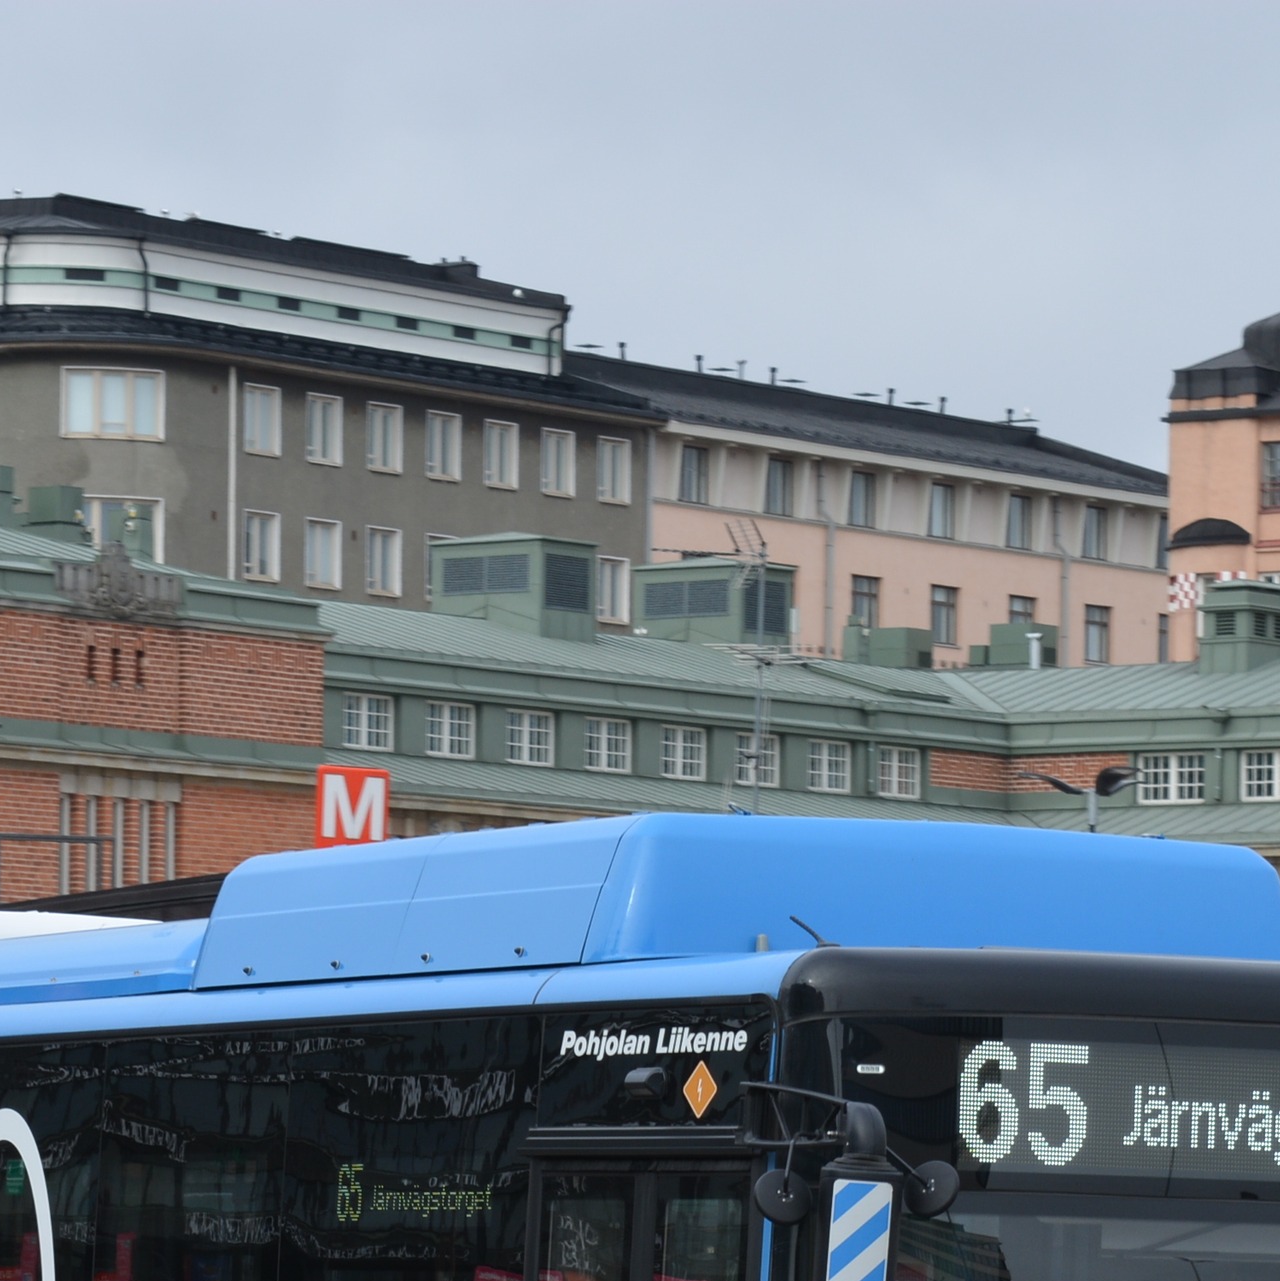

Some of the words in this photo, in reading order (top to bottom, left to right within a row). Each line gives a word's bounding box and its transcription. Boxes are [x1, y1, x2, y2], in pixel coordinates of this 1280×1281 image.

[320, 772, 387, 841] M
[561, 1029, 650, 1061] Pohjolan
[656, 1025, 748, 1055] Liikenne
[959, 1040, 1090, 1166] 65
[336, 1163, 364, 1222] 65
[370, 1183, 493, 1218] Järnvägstorget
